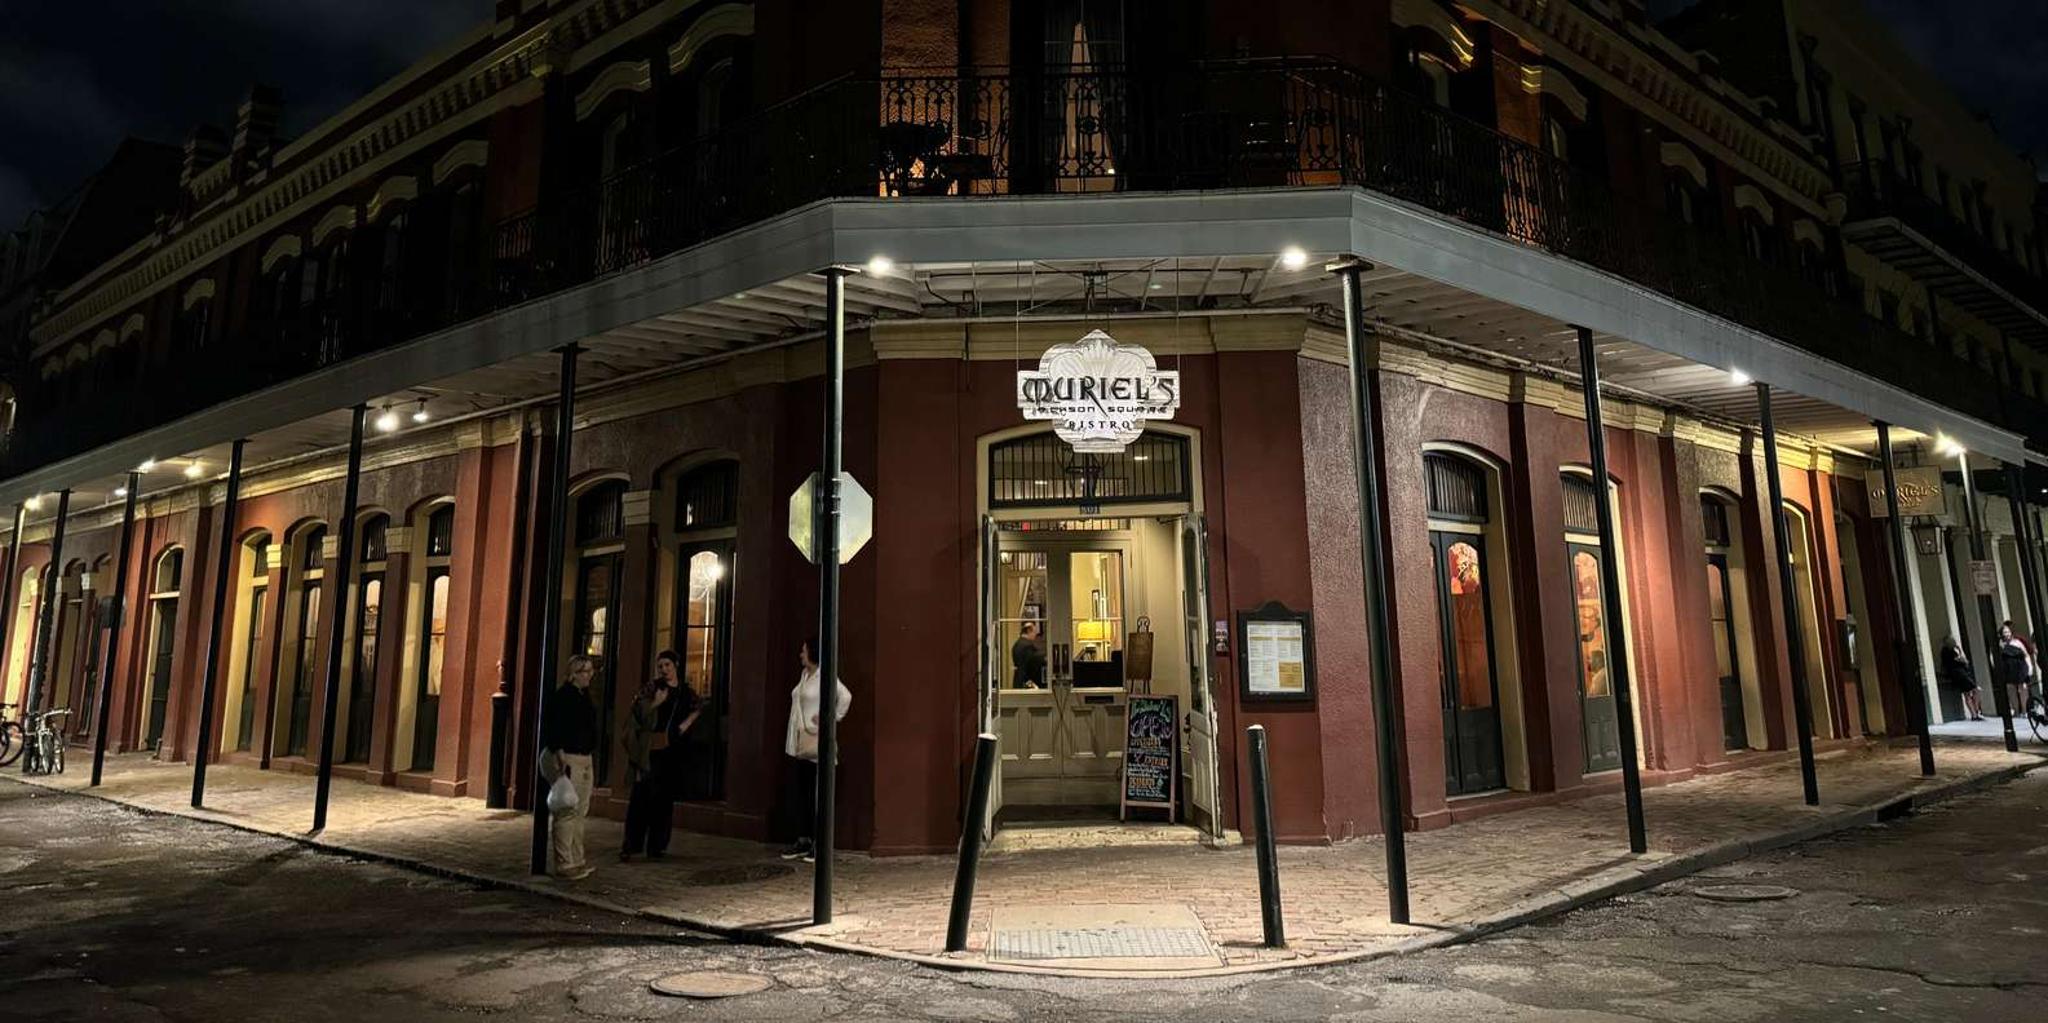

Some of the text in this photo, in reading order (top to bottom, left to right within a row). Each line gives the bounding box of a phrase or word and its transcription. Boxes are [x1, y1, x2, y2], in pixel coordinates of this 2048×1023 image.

[1022, 376, 1175, 412] MURIEL'S
[1107, 405, 1168, 414] SQUARE
[1068, 420, 1131, 431] BISTRO
[1872, 483, 1941, 501] MRIEL'S
